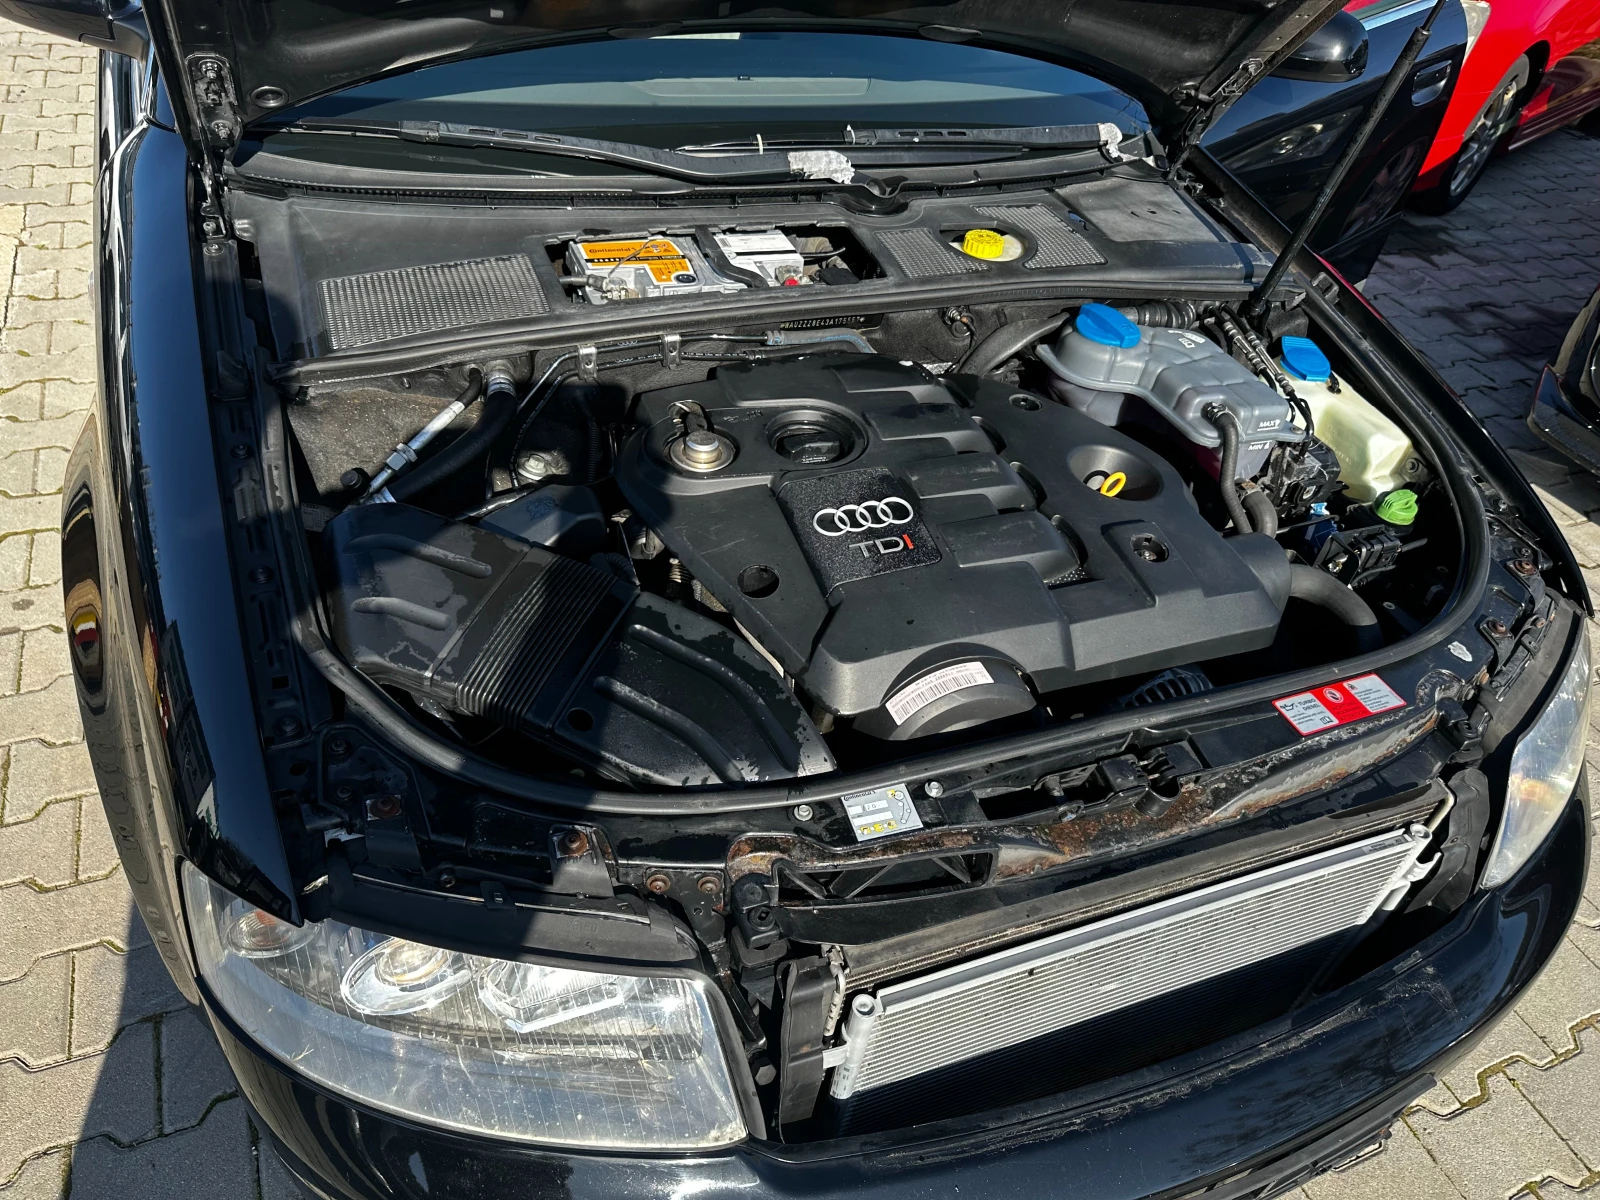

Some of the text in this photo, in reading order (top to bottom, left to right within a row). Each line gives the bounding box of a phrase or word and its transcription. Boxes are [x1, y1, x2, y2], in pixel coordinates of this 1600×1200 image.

[1259, 420, 1276, 428] MAX
[1248, 443, 1263, 451] MIN
[848, 533, 914, 558] TDI
[1298, 698, 1316, 707] TURBO
[1303, 703, 1321, 711] DIESEL
